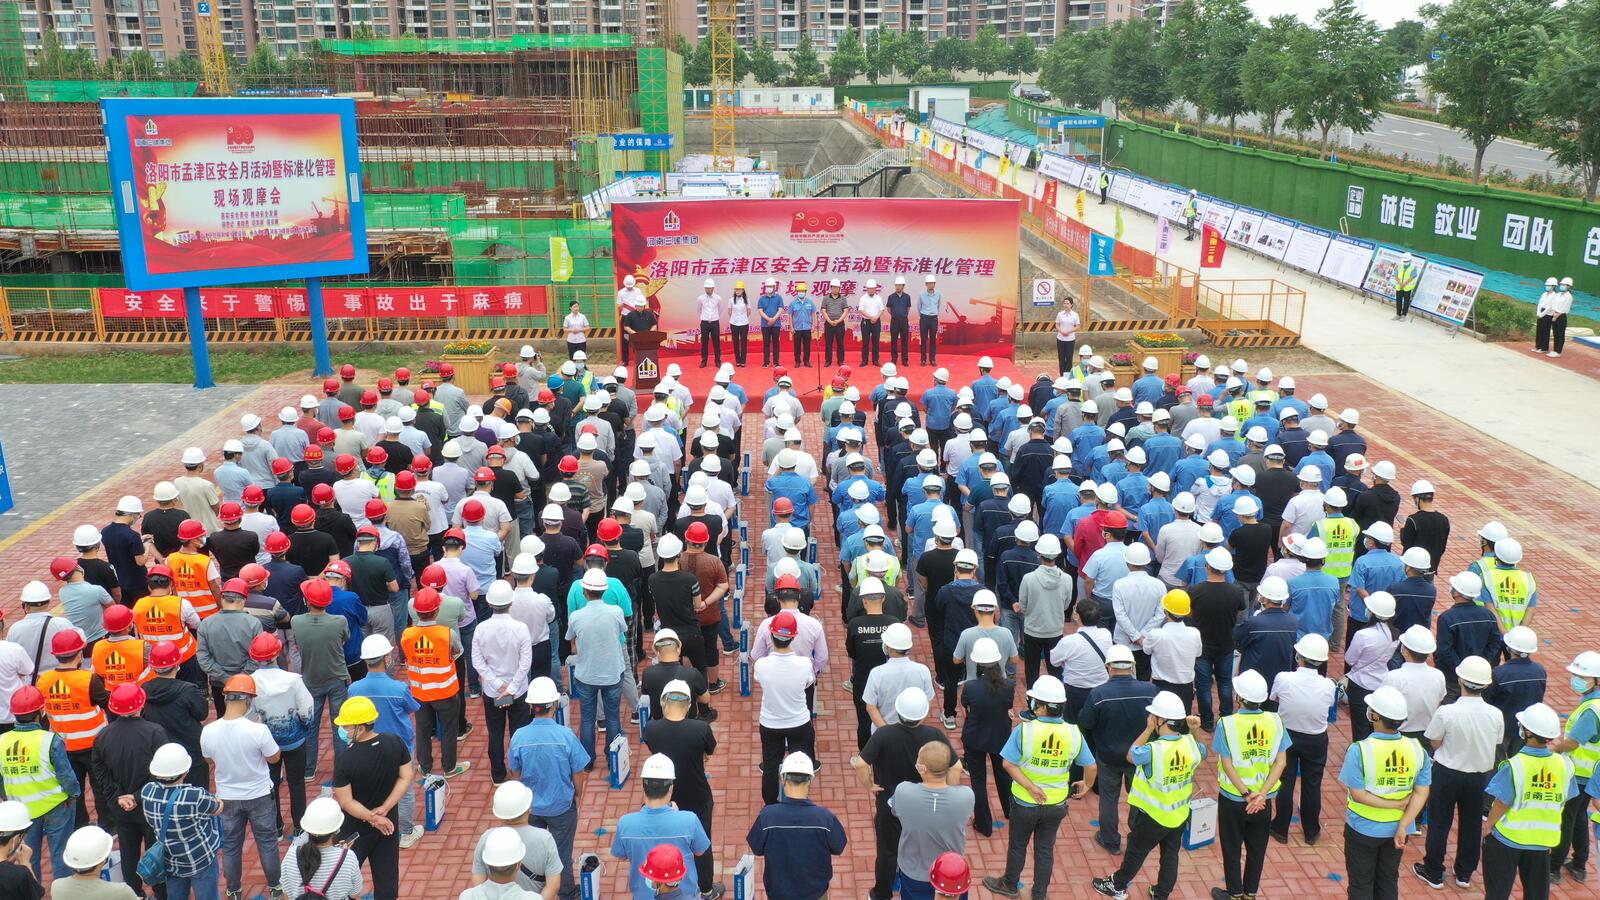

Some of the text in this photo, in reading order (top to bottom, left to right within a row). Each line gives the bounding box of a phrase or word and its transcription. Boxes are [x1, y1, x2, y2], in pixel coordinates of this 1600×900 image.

[145, 158, 336, 184] 洛阳市孟津区安全月活动暨标准化管理
[213, 187, 281, 207] 现场观摩会
[1380, 194, 1416, 229] 诚信
[1434, 203, 1481, 240] 敬业
[1503, 213, 1554, 256] 团队
[650, 257, 996, 279] 洛阳市孟津区安全月活动暨标准化管理
[343, 292, 522, 311] 事故出于麻痹
